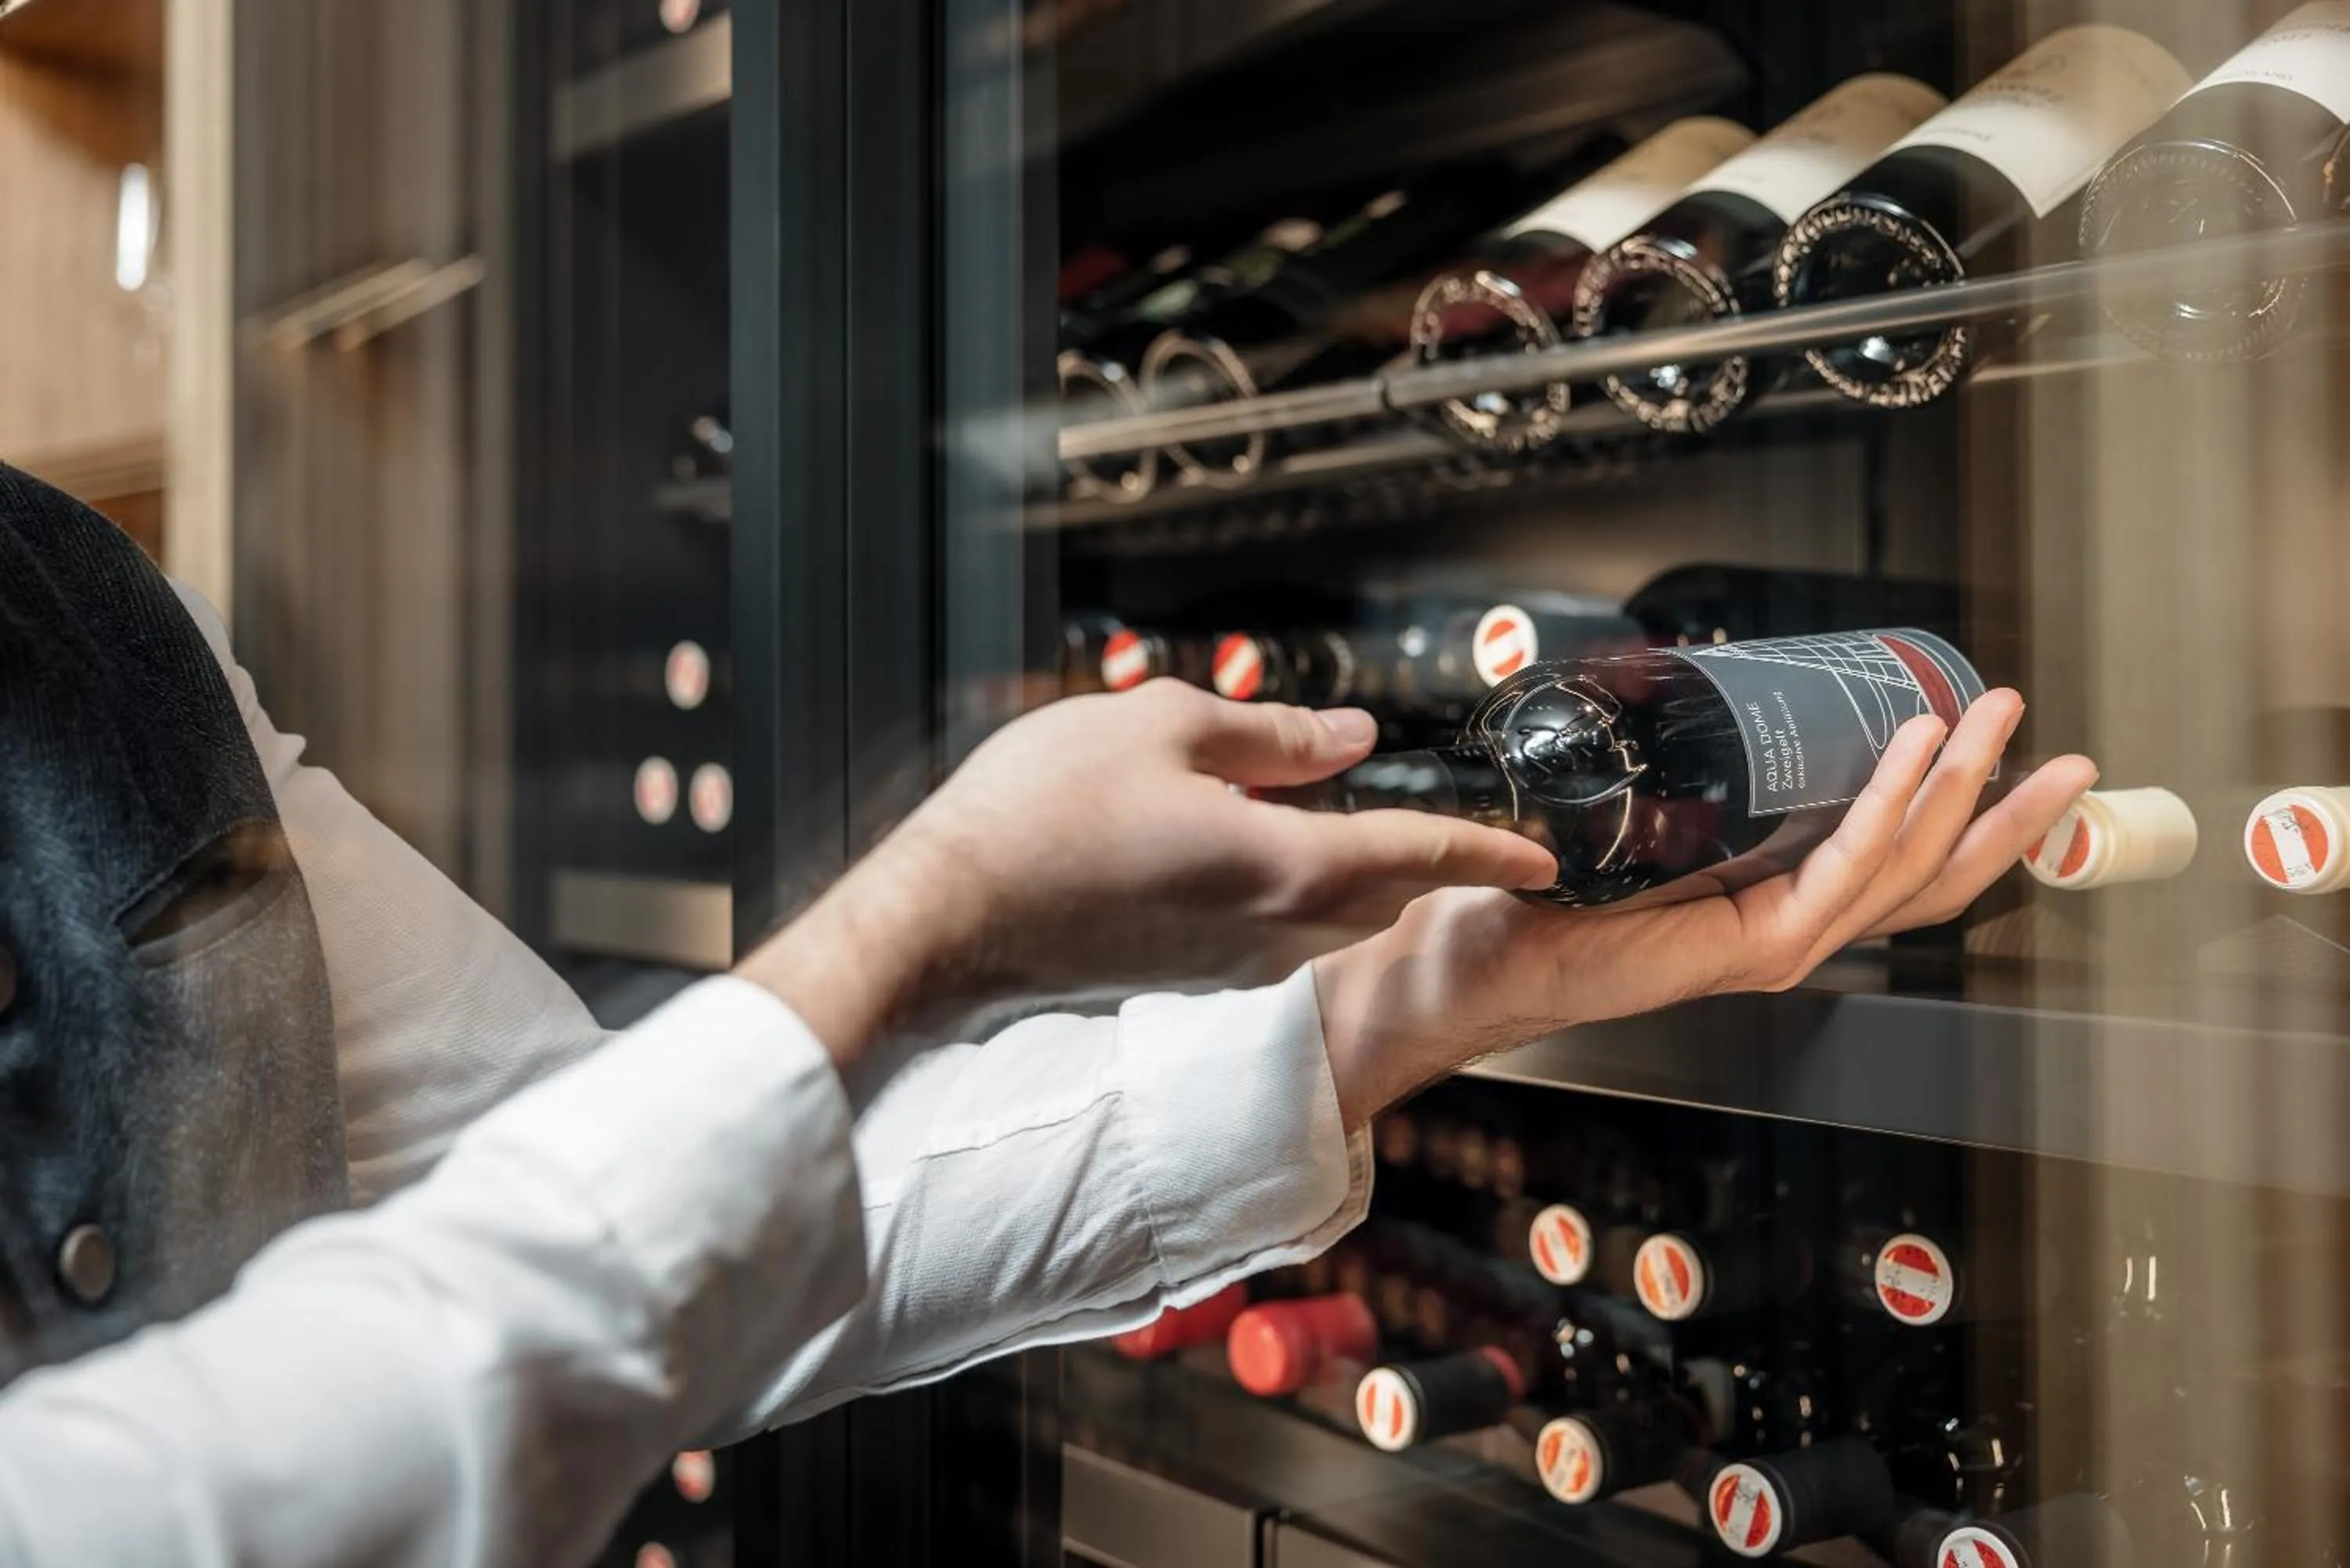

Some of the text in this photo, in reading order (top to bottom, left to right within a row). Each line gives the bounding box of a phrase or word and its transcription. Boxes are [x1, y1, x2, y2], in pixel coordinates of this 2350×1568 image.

[1746, 702, 1778, 792] AQUA DOME
[1773, 728, 1793, 790] Zweigelt
